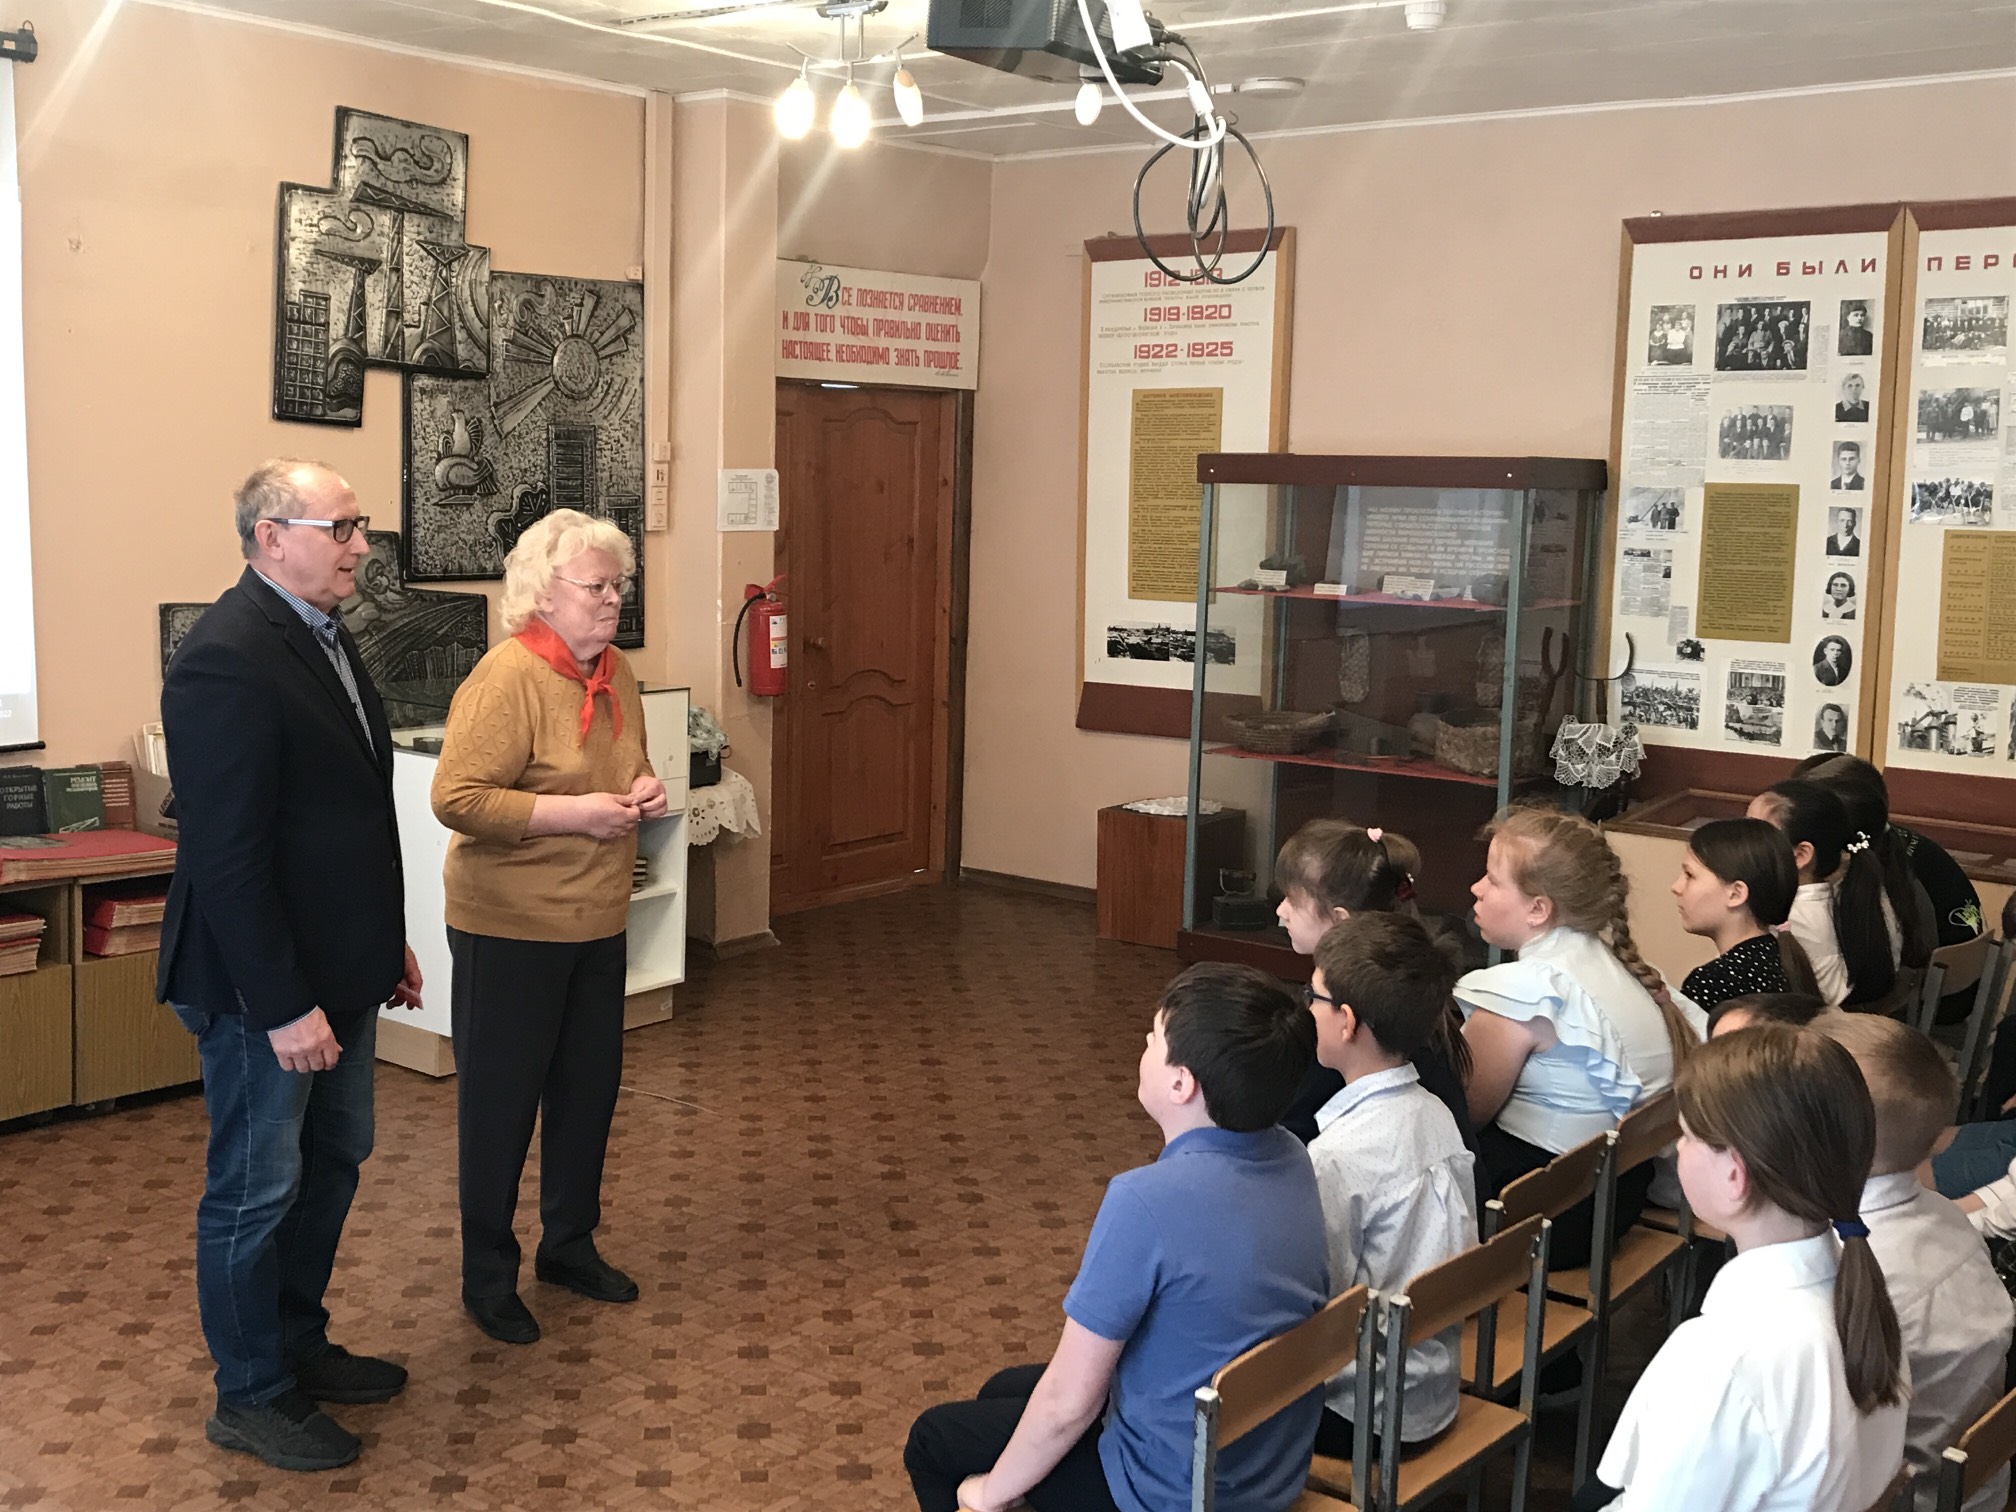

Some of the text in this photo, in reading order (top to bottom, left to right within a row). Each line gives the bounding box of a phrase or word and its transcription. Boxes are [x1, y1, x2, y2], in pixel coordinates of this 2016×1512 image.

[1689, 254, 2016, 280] ОНИ БЫЛИ ПЕР
[856, 287, 904, 311] ПОЗНАЕТСЯ
[782, 310, 961, 343] И ДЛЯ ТОГО ЧТОБЫ ПРАВИЛЬНО ОЦЕНИТЬ
[835, 343, 890, 366] НЕОБХОДИМО
[894, 348, 920, 367] ЗНАТЬ
